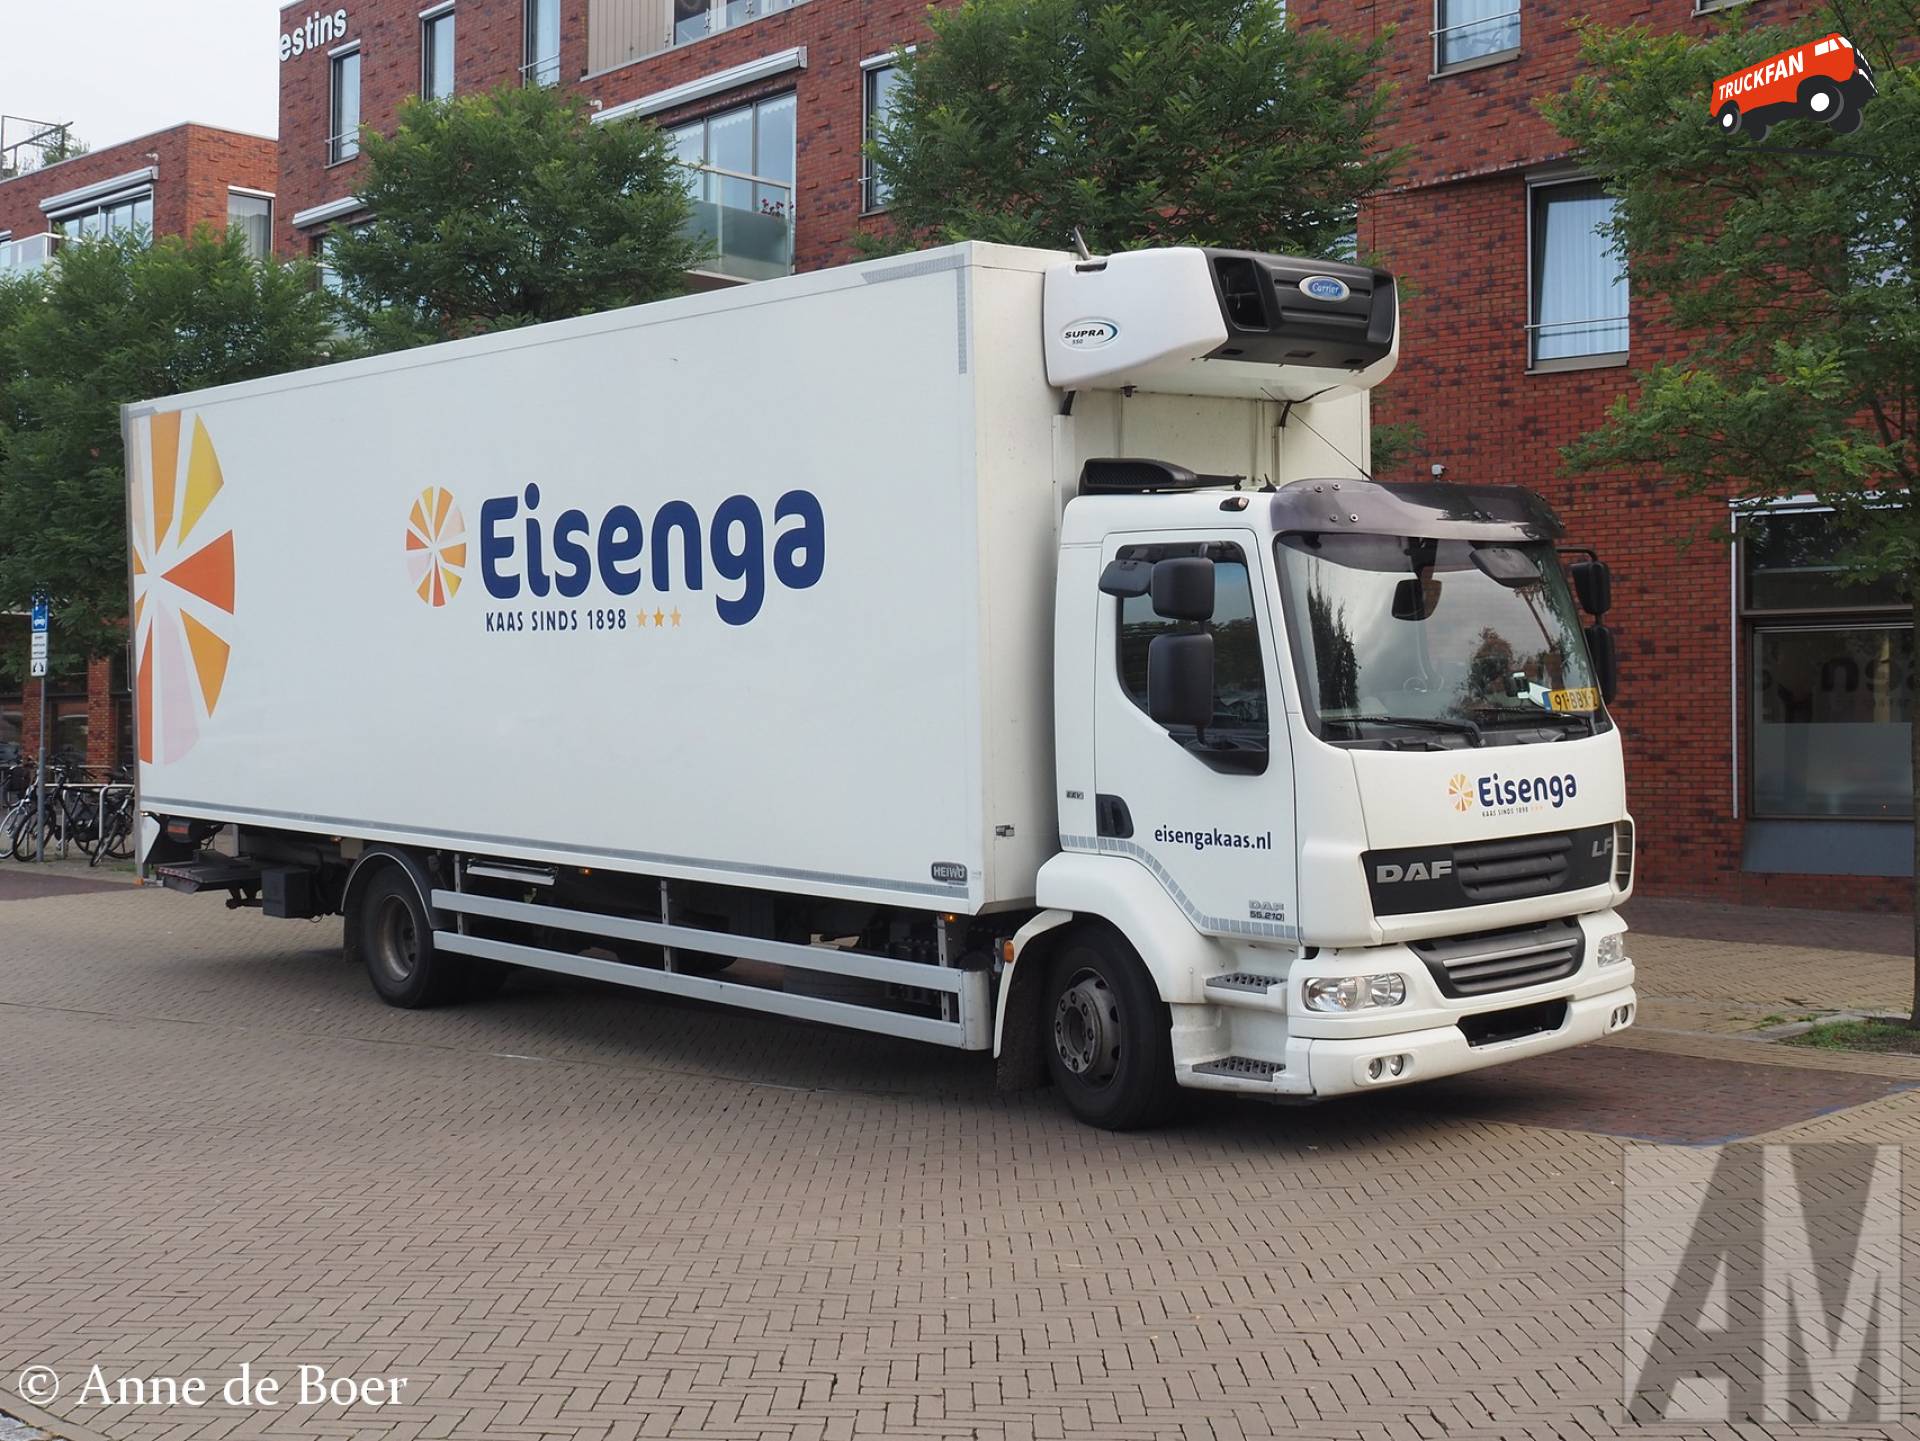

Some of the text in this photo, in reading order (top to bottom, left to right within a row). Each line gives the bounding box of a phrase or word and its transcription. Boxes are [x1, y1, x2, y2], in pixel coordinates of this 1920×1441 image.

[1311, 282, 1340, 295] Carrier
[1064, 329, 1105, 339] SUPRA
[480, 482, 826, 626] Eisenga
[485, 608, 627, 632] KAAS SINDS 1898
[1478, 773, 1577, 808] Eisenga
[1154, 824, 1272, 850] eisengakaas.nl
[1591, 837, 1613, 858] LF
[1376, 860, 1452, 884] DAF
[1248, 900, 1285, 911] DAF
